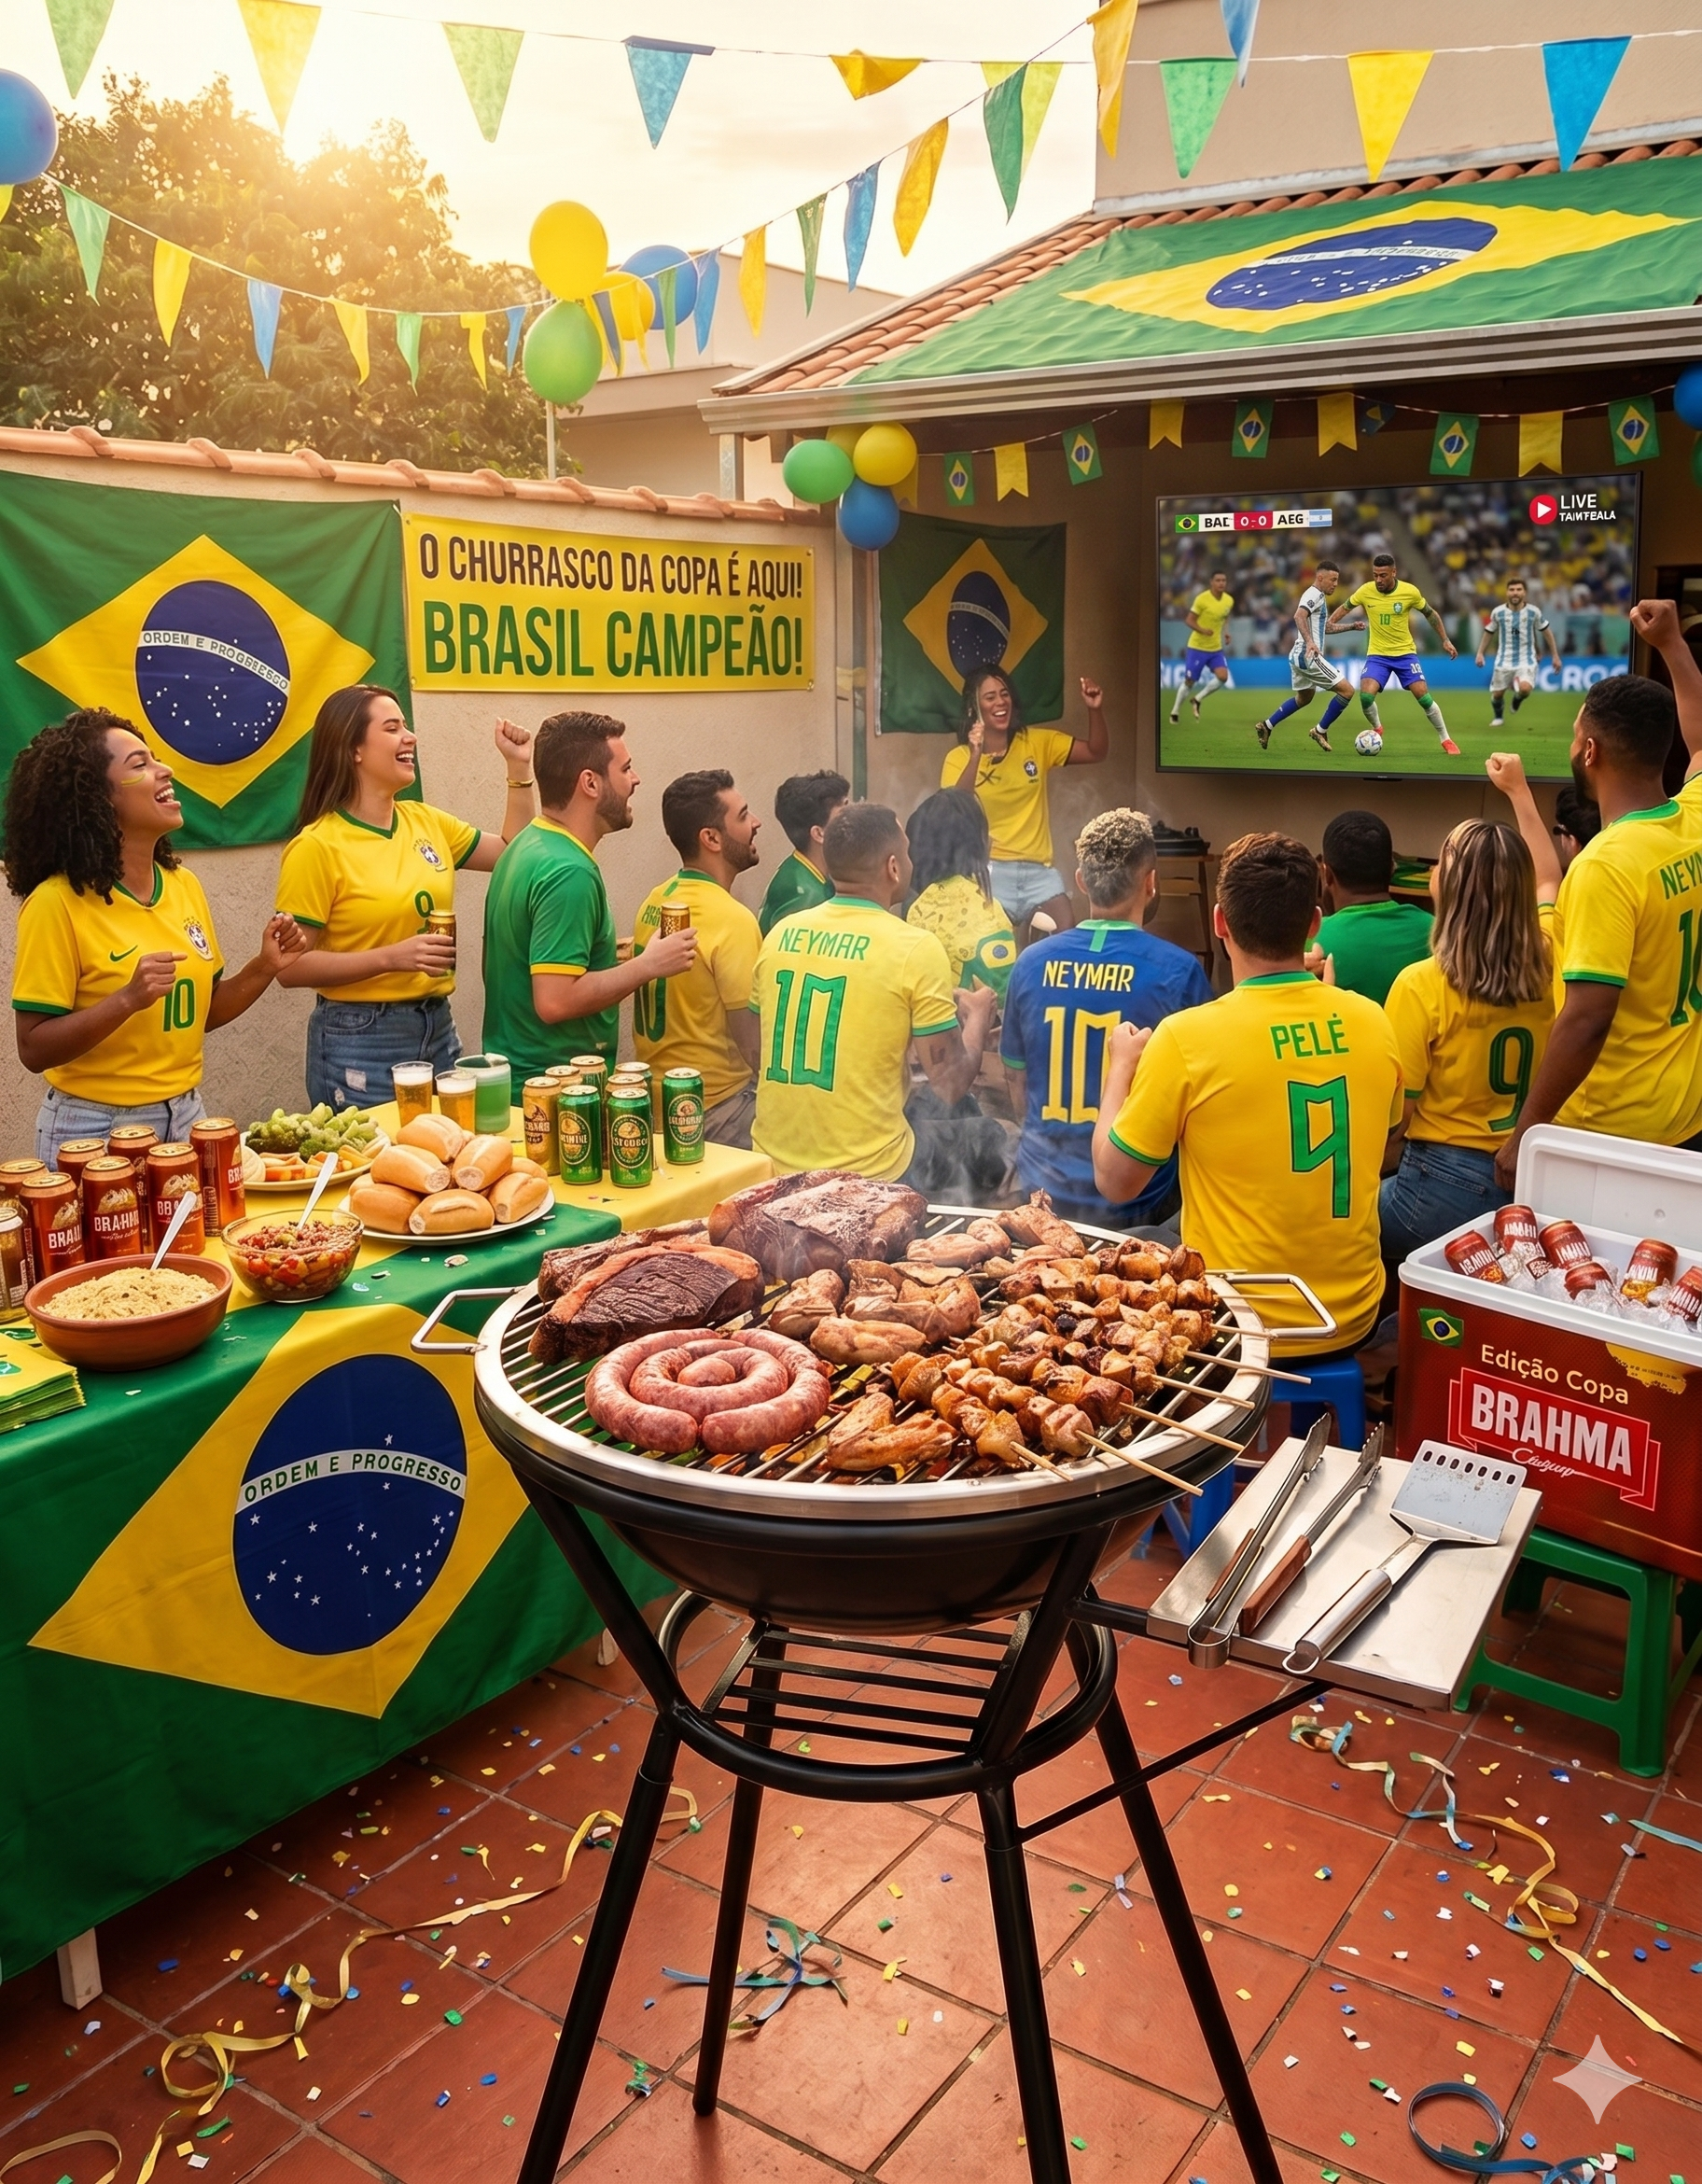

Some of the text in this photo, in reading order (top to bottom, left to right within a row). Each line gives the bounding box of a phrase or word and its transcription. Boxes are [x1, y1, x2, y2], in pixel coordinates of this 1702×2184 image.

[1277, 513, 1304, 525] AEG
[1560, 494, 1597, 510] LIVE
[419, 532, 802, 601] O CHURRASCO DA COPA É AQUI!
[143, 632, 189, 646] ORDEM
[196, 637, 204, 649] E
[423, 600, 803, 678] BRASIL CAMPEÃO!
[777, 928, 871, 961] NEYMAR
[163, 978, 195, 1032] 10
[1042, 960, 1135, 992] NEYMAR
[766, 969, 847, 1092] 10
[1041, 1006, 1122, 1125] 10
[1488, 1027, 1534, 1133] 9
[1288, 1075, 1350, 1219] 9
[1481, 1344, 1629, 1405] Edição Copa
[1472, 1382, 1632, 1477] BRAHMA
[244, 1453, 461, 1503] ORDEM E PROGRESSO
